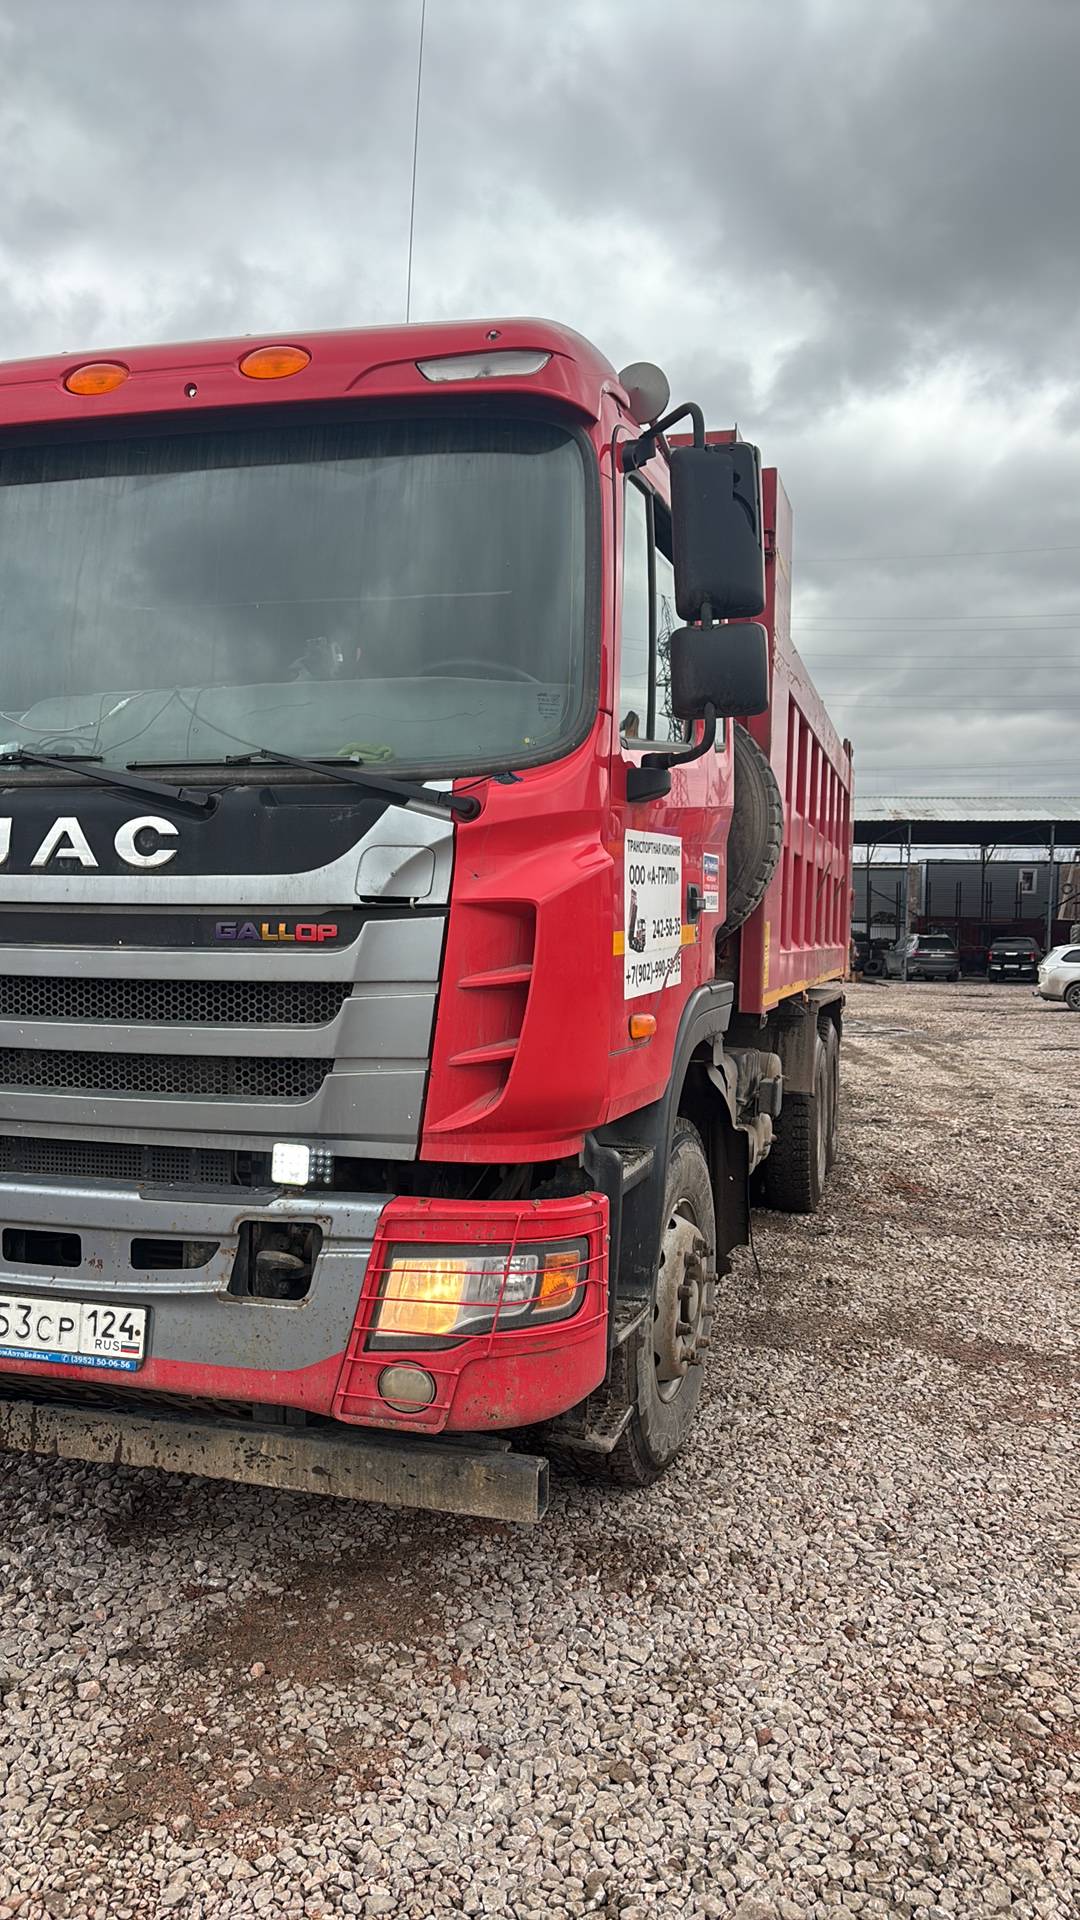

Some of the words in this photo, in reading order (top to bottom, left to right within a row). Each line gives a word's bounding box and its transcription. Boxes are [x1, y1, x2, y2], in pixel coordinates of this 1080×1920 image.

[629, 865, 646, 885] ООО
[215, 921, 338, 942] GALLOP
[652, 917, 681, 938] 242-58-35
[87, 1309, 134, 1341] 124
[94, 1338, 120, 1352] RUS
[70, 1356, 95, 1366] (3952)
[96, 1359, 131, 1369] 50-06-56
